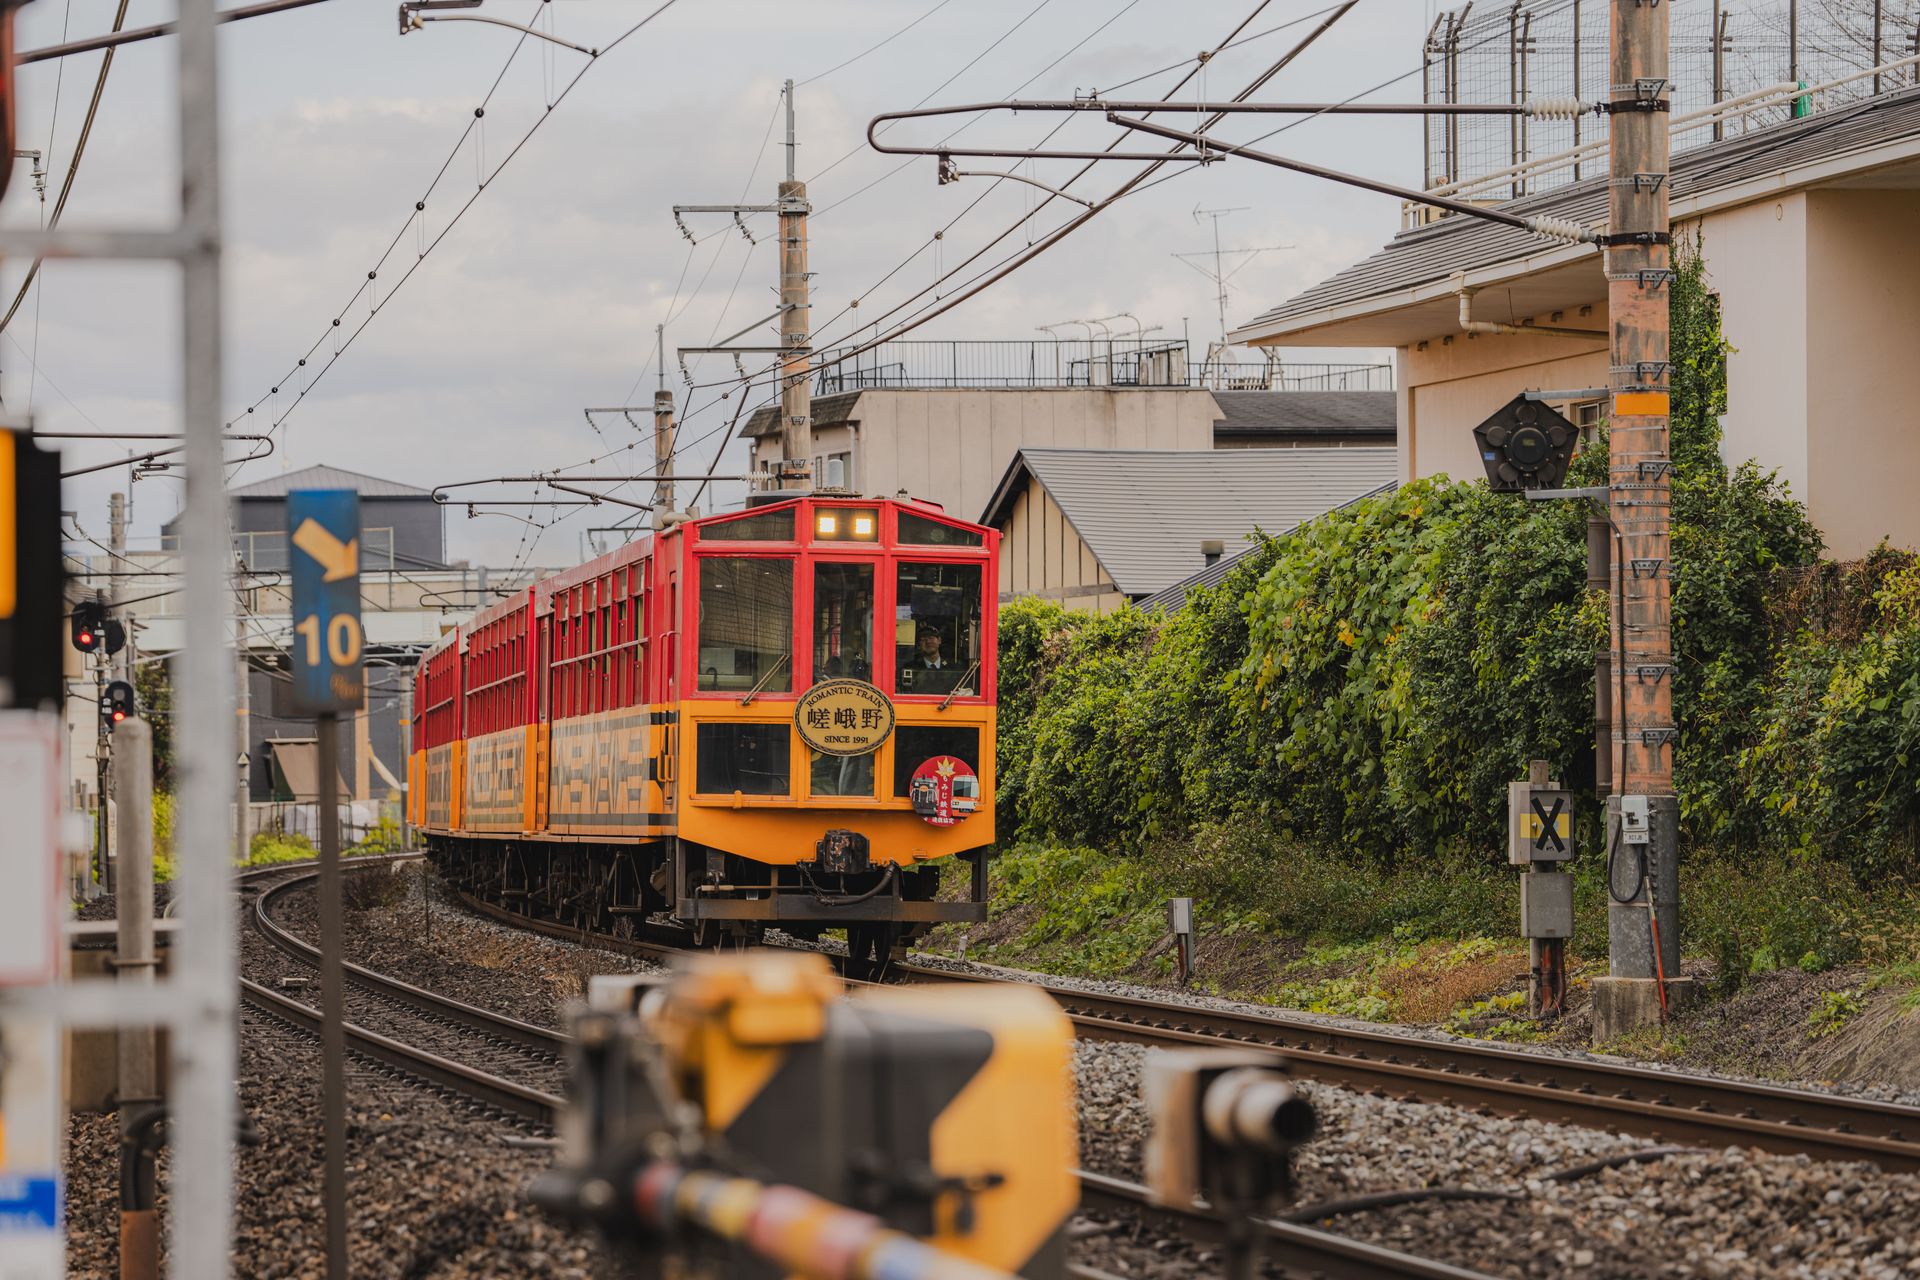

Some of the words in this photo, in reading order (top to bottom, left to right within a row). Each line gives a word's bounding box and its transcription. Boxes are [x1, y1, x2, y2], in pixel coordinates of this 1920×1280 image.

[296, 613, 361, 666] 10
[807, 687, 853, 707] ROMANTIC
[856, 689, 883, 709] TRAIN
[807, 707, 883, 729] 嵯峨野
[824, 735, 850, 743] SINCE
[853, 736, 869, 744] 1991
